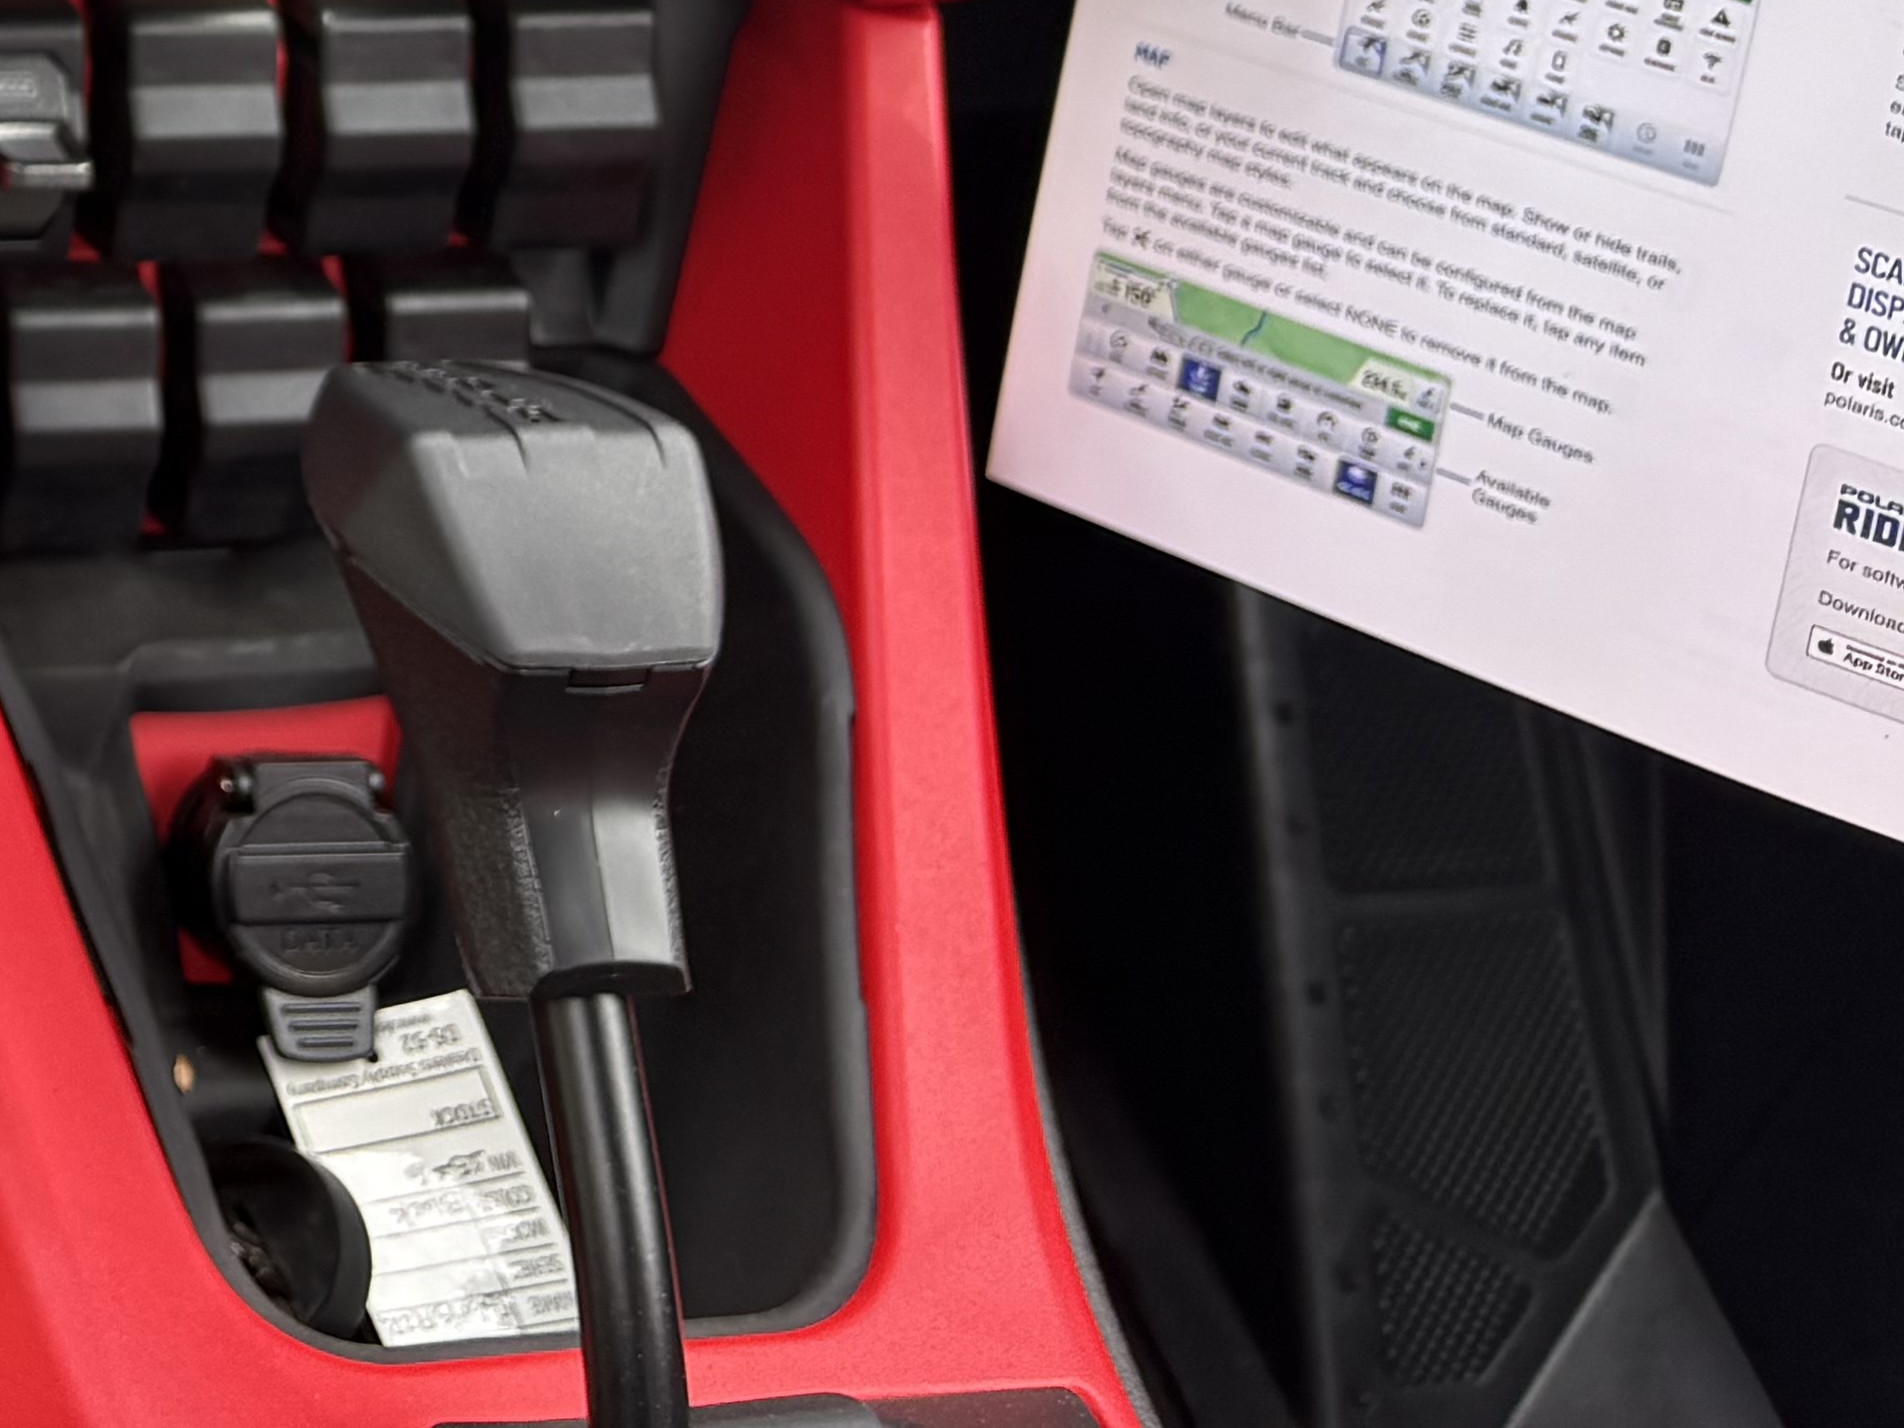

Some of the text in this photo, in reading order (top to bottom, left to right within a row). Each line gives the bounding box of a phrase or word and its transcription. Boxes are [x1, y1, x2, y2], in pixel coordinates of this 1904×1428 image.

[1521, 206, 1570, 234] Show
[1594, 232, 1632, 256] hide
[1572, 250, 1641, 285] satellite,
[1853, 246, 1904, 286] SCA
[1525, 288, 1564, 315] from
[1567, 304, 1595, 325] the
[1598, 316, 1637, 340] map
[1847, 282, 1904, 322] DISP
[1572, 333, 1605, 355] any
[1608, 343, 1646, 366] item
[1838, 318, 1904, 362] & OW
[1498, 360, 1538, 386] from
[1540, 376, 1569, 397] the
[1830, 361, 1896, 400] Or visit
[1486, 412, 1524, 439] Map
[1840, 483, 1904, 515] POLA
[1832, 498, 1904, 553] RID
[1826, 548, 1859, 573] For
[1842, 652, 1874, 673] App
[1875, 662, 1904, 682] Stor
